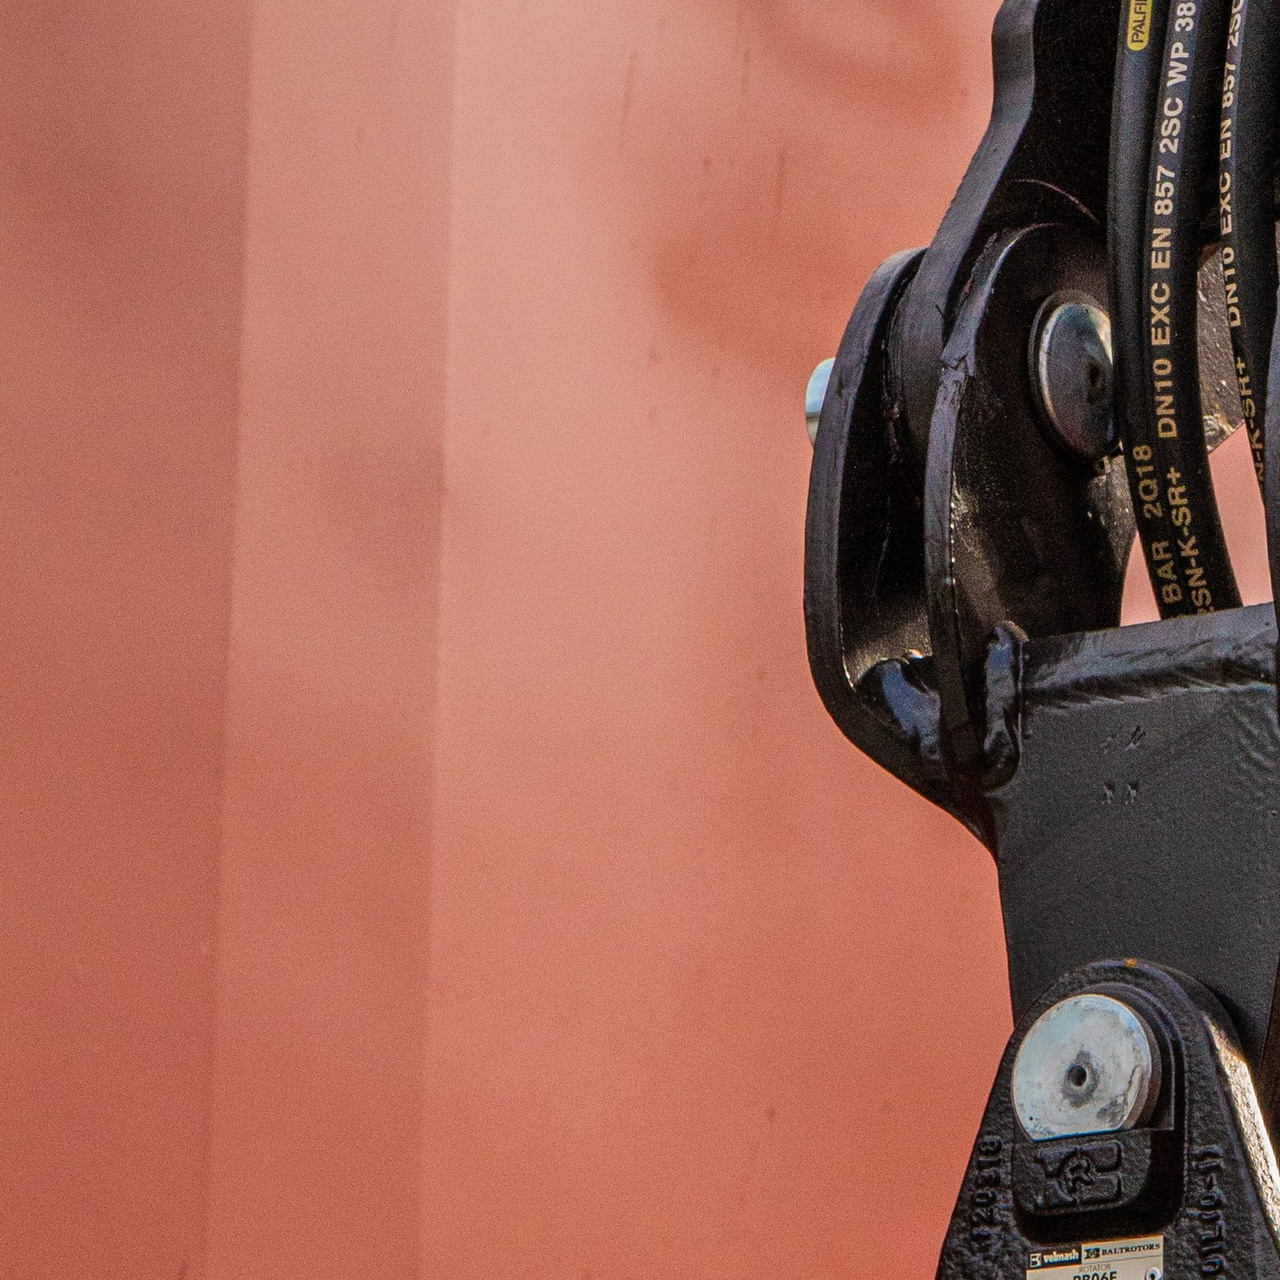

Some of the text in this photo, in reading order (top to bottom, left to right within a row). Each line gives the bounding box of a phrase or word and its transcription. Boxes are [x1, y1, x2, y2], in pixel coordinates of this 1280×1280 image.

[1167, 41, 1192, 89] WP
[1221, 57, 1238, 109] 857
[1158, 96, 1183, 154] 2SC
[1218, 118, 1234, 162] EN
[1154, 165, 1177, 217] 857
[1219, 170, 1234, 235] EXC
[1151, 228, 1171, 270] EN
[1151, 282, 1171, 346] EXC
[1223, 246, 1242, 328] DN10
[1152, 360, 1177, 439] DN10
[1132, 445, 1182, 604] BAR 2Q18
[1166, 466, 1213, 613] SN-K-SR+
[1078, 1263, 1112, 1273] ROTATOR
[1101, 1243, 1161, 1257] BALTROTORS
